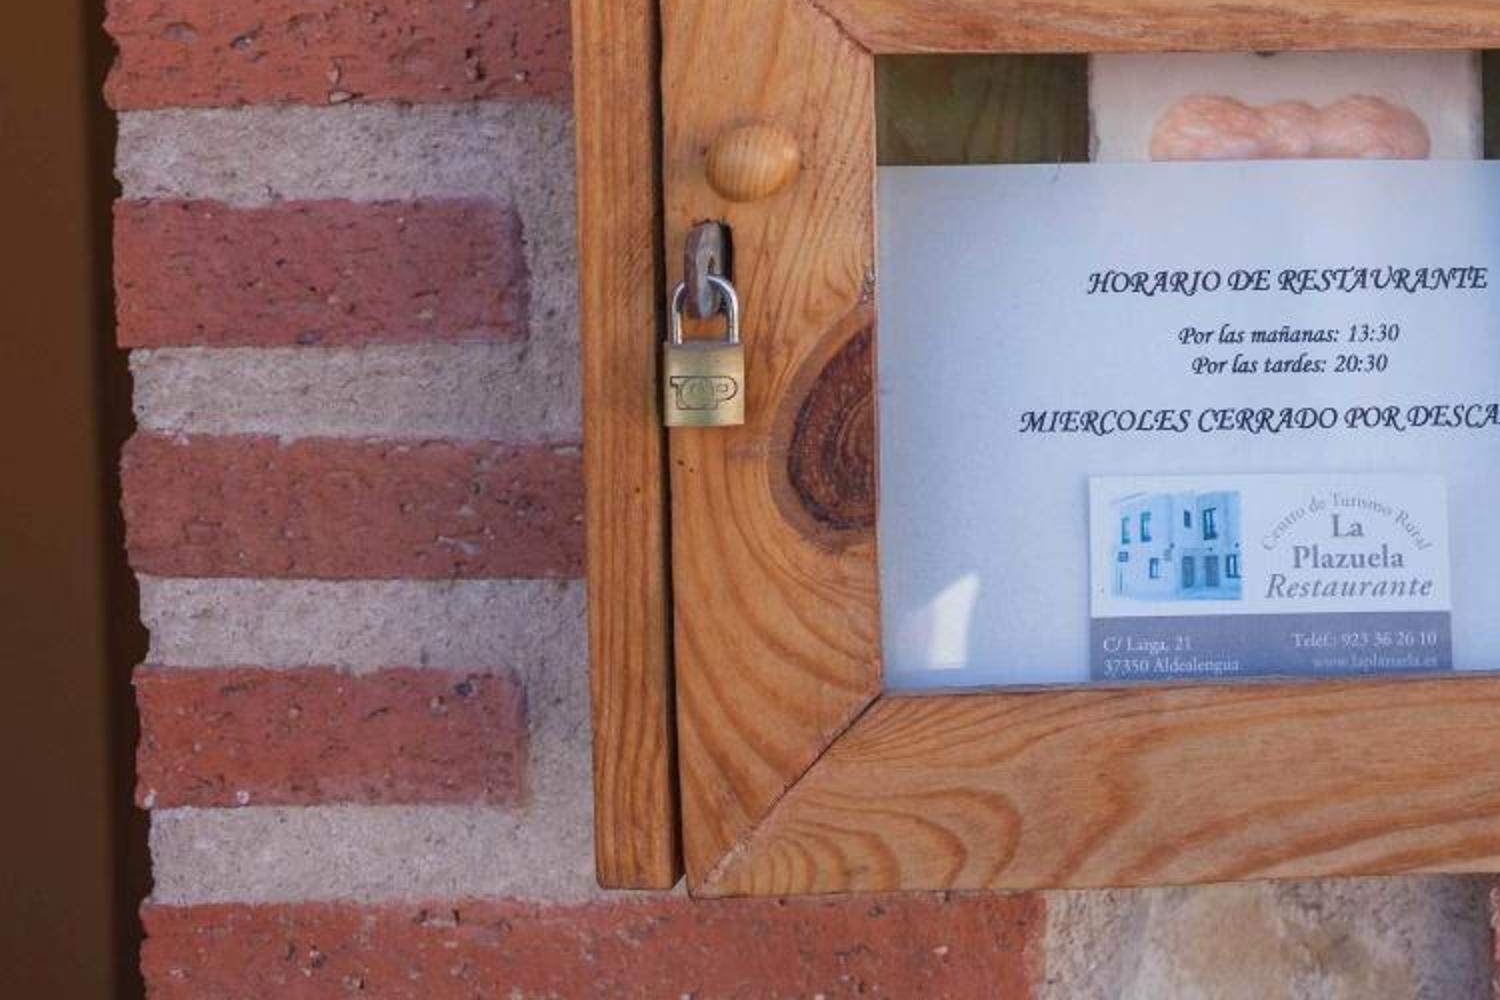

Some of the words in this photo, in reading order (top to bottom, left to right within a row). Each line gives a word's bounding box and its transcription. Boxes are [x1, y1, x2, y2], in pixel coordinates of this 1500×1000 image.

[1086, 268, 1222, 296] HORARIO
[1227, 268, 1272, 292] DE
[1277, 265, 1489, 294] RESTAURANTE
[1178, 324, 1214, 345] Por
[1220, 322, 1245, 344] las
[1250, 322, 1340, 344] mañanas:
[1348, 322, 1400, 343] 13:30
[1192, 354, 1228, 375] Por
[1233, 353, 1259, 374] las
[1263, 353, 1327, 374] tardes:
[1333, 353, 1388, 373] 20:30
[1019, 407, 1190, 434] MIERCOLES
[1196, 407, 1338, 433] CERRADO
[1344, 405, 1406, 431] POR
[1262, 507, 1307, 552] Centro
[1308, 496, 1328, 514] de
[1329, 490, 1394, 517] Turismo
[1394, 507, 1433, 552] Rural
[1330, 513, 1365, 538] La
[1291, 544, 1405, 570] Plazuela
[1264, 574, 1434, 600] Restaurante
